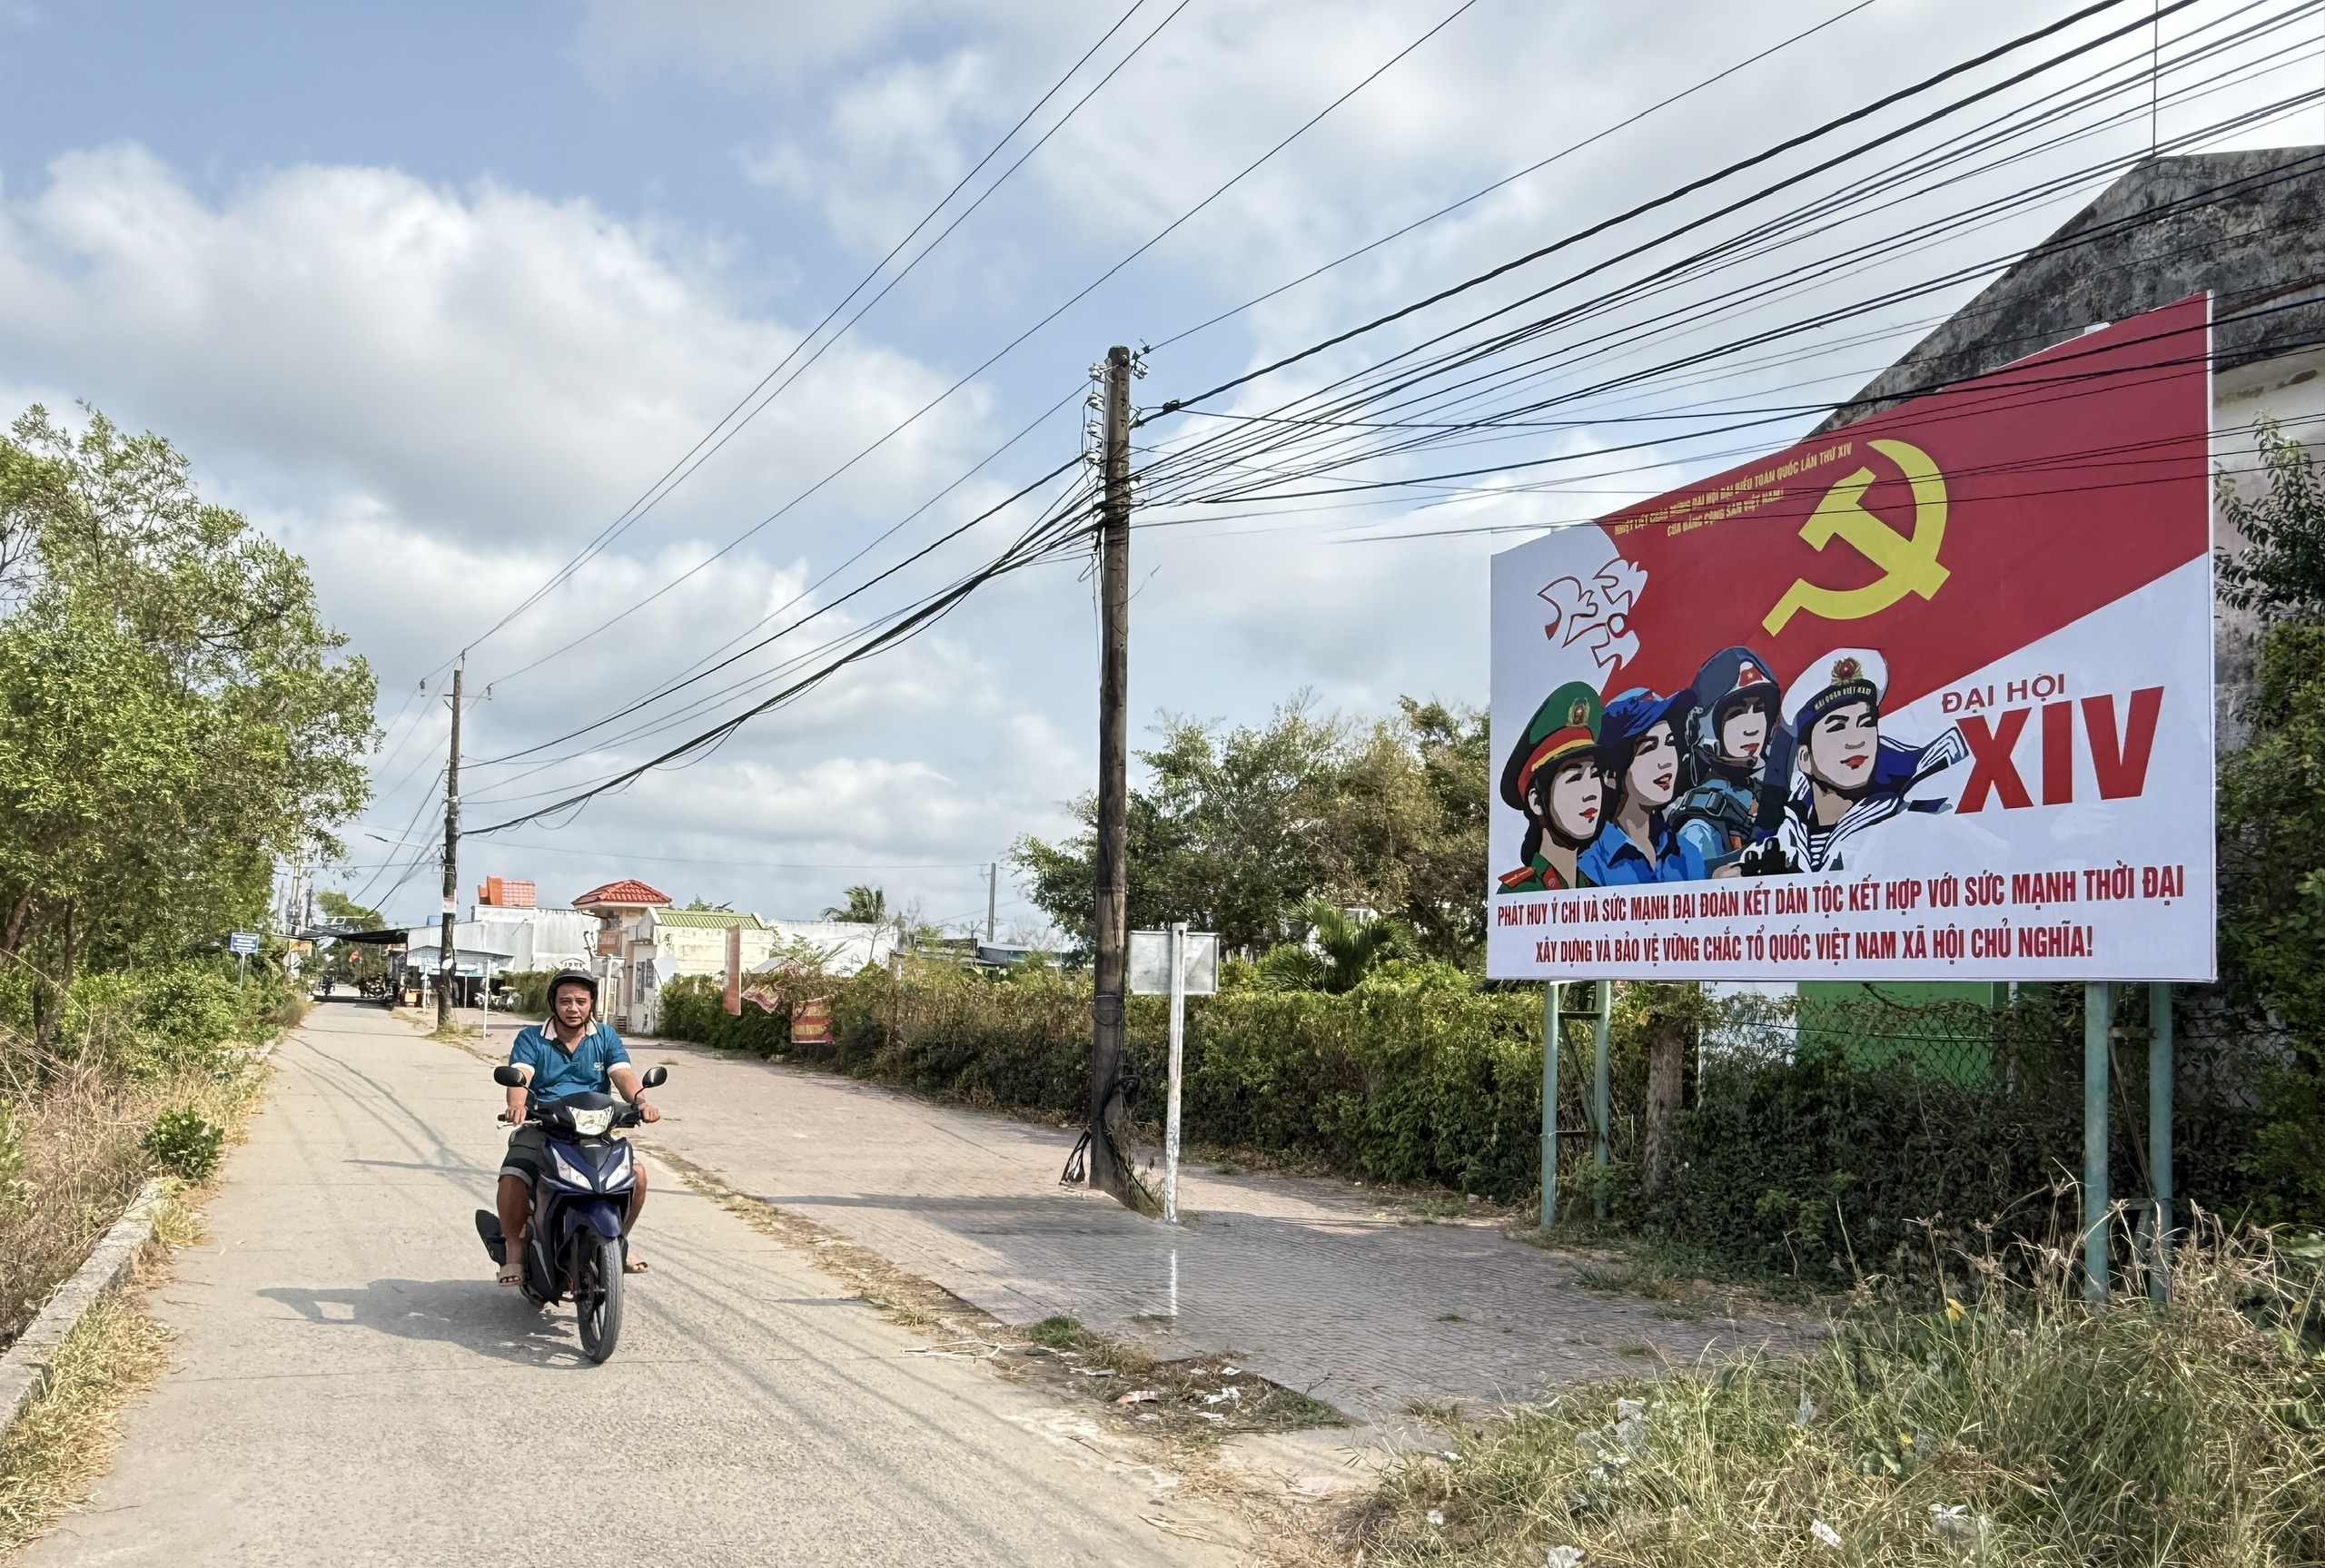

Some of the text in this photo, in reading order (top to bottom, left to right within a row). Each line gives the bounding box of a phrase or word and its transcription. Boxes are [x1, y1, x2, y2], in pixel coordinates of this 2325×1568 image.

[1755, 469, 1776, 488] TOÀN
[1776, 459, 1799, 480] QUỐC
[1819, 446, 1836, 465] THỨ
[1837, 441, 1853, 459] XIV
[1942, 673, 2064, 714] ĐẠI HỘI
[1954, 685, 2164, 814] XIV
[1498, 859, 2183, 927] PHÁT HUY Ý CHÍ VÀ SỨC MẠNH ĐẠI ĐOÀN KẾT DÂN TỘC KẾT HỢP VỚI SỨC MẠNH THỜI ĐẠI
[1536, 917, 2092, 968] XÂY DỰNG VÀ BẢO VỆ VỮNG CHẮC TỔ QUỐC VIỆT NAM XÃ HỘI CHỦ NGHĨA!
